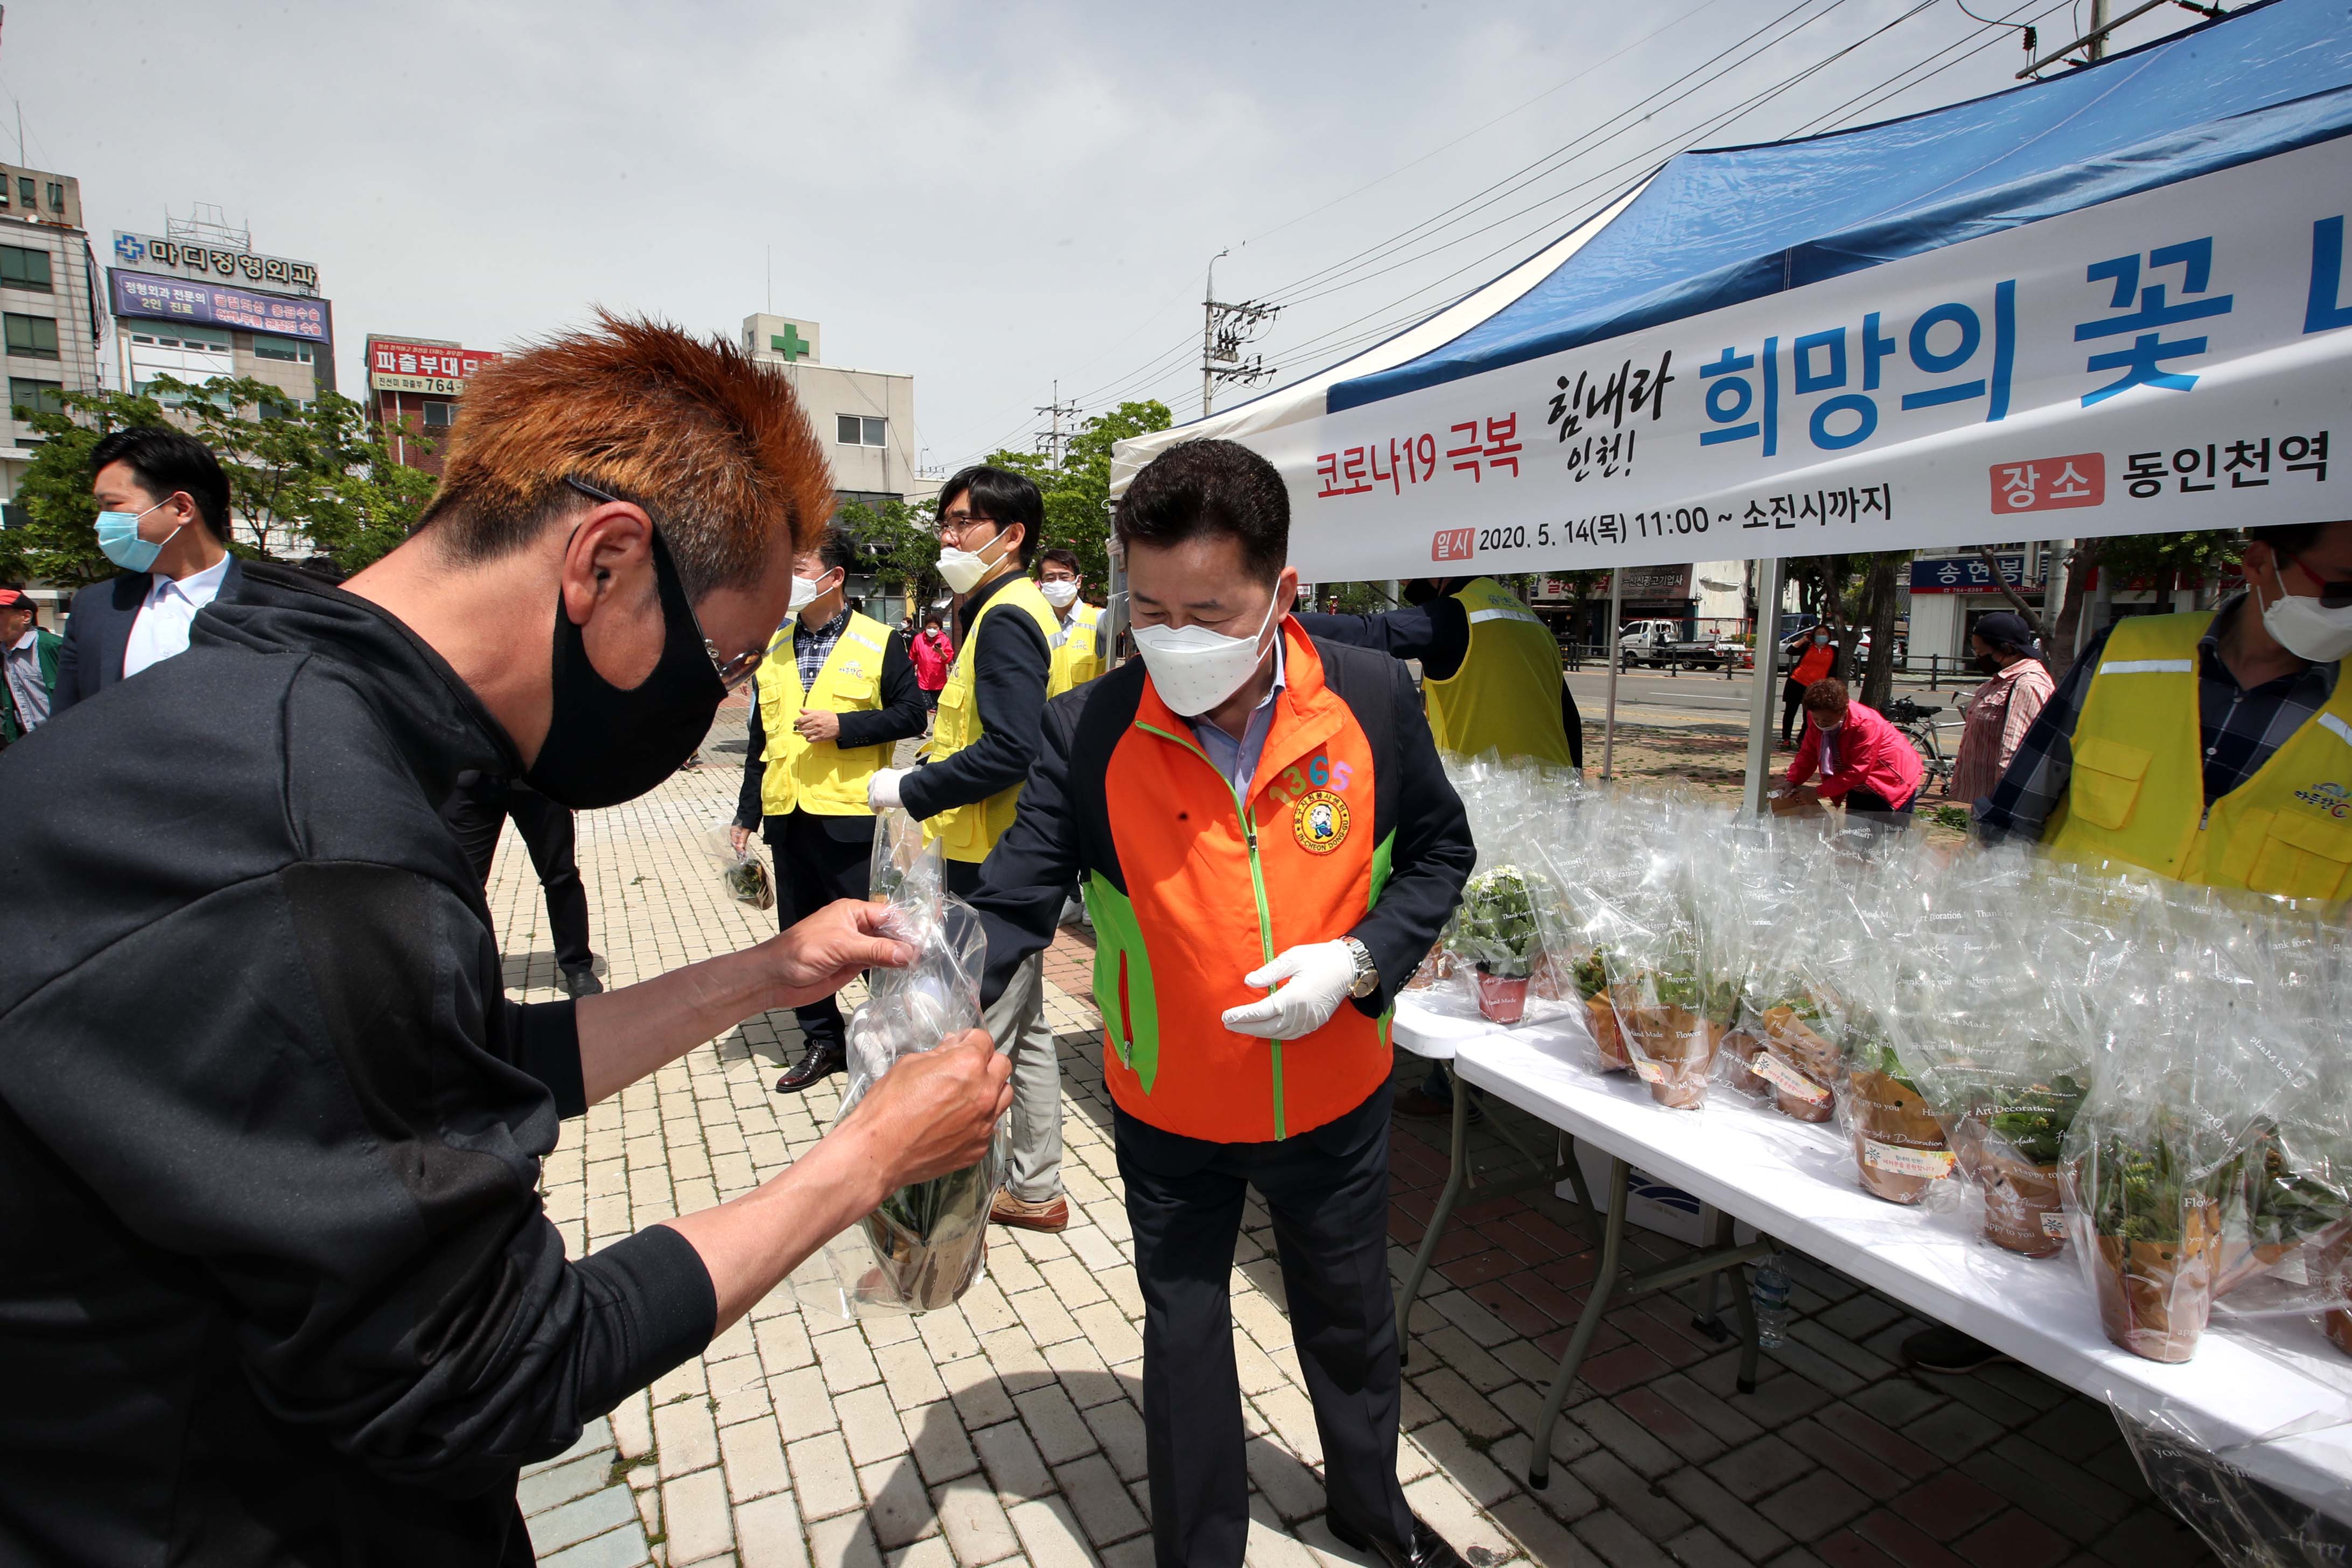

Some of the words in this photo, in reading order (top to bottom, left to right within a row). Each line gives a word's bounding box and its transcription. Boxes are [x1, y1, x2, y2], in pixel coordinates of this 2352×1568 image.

[150, 240, 317, 287] 마디정형외과
[124, 281, 170, 299] 정형외과
[172, 289, 206, 305] 전문의
[141, 298, 162, 310] 2인
[170, 301, 194, 314] 진료
[271, 304, 320, 321] 응급수술
[299, 321, 322, 336] 수술
[1699, 278, 2015, 457] 희망의
[2074, 236, 2234, 409] 꽃
[1548, 350, 1675, 443] 힘내라
[1317, 433, 1436, 499] 코로나19
[1446, 412, 1523, 484] 극복
[1567, 430, 1636, 483] 인천!
[2001, 461, 2091, 508] 장소
[2122, 431, 2329, 499] 동인천역
[1479, 527, 1531, 551] 2020.
[1538, 521, 1556, 548] 5.
[1563, 513, 1627, 545] 14(목)
[1635, 507, 1709, 537] 11:00
[1742, 482, 1892, 530] 소진시까지
[1437, 531, 1468, 557] 일시
[1629, 573, 1683, 586] 신신광고기업사
[1936, 559, 2047, 584] 송현봉
[1269, 755, 1353, 808] 1365
[1297, 832, 1327, 851] IN-CHEON
[1328, 820, 1349, 849] DONG-GU
[1675, 1030, 1702, 1039] Flower
[1884, 1103, 1900, 1112] you
[1975, 1106, 1993, 1116] Art
[1993, 1104, 2056, 1114] Decoration
[1894, 1133, 1943, 1147] Decoration
[1978, 1135, 2008, 1145] Hand
[2011, 1135, 2037, 1147] Made
[2013, 1166, 2045, 1180] Happy
[2018, 1230, 2035, 1238] you
[2153, 1448, 2183, 1459] you
